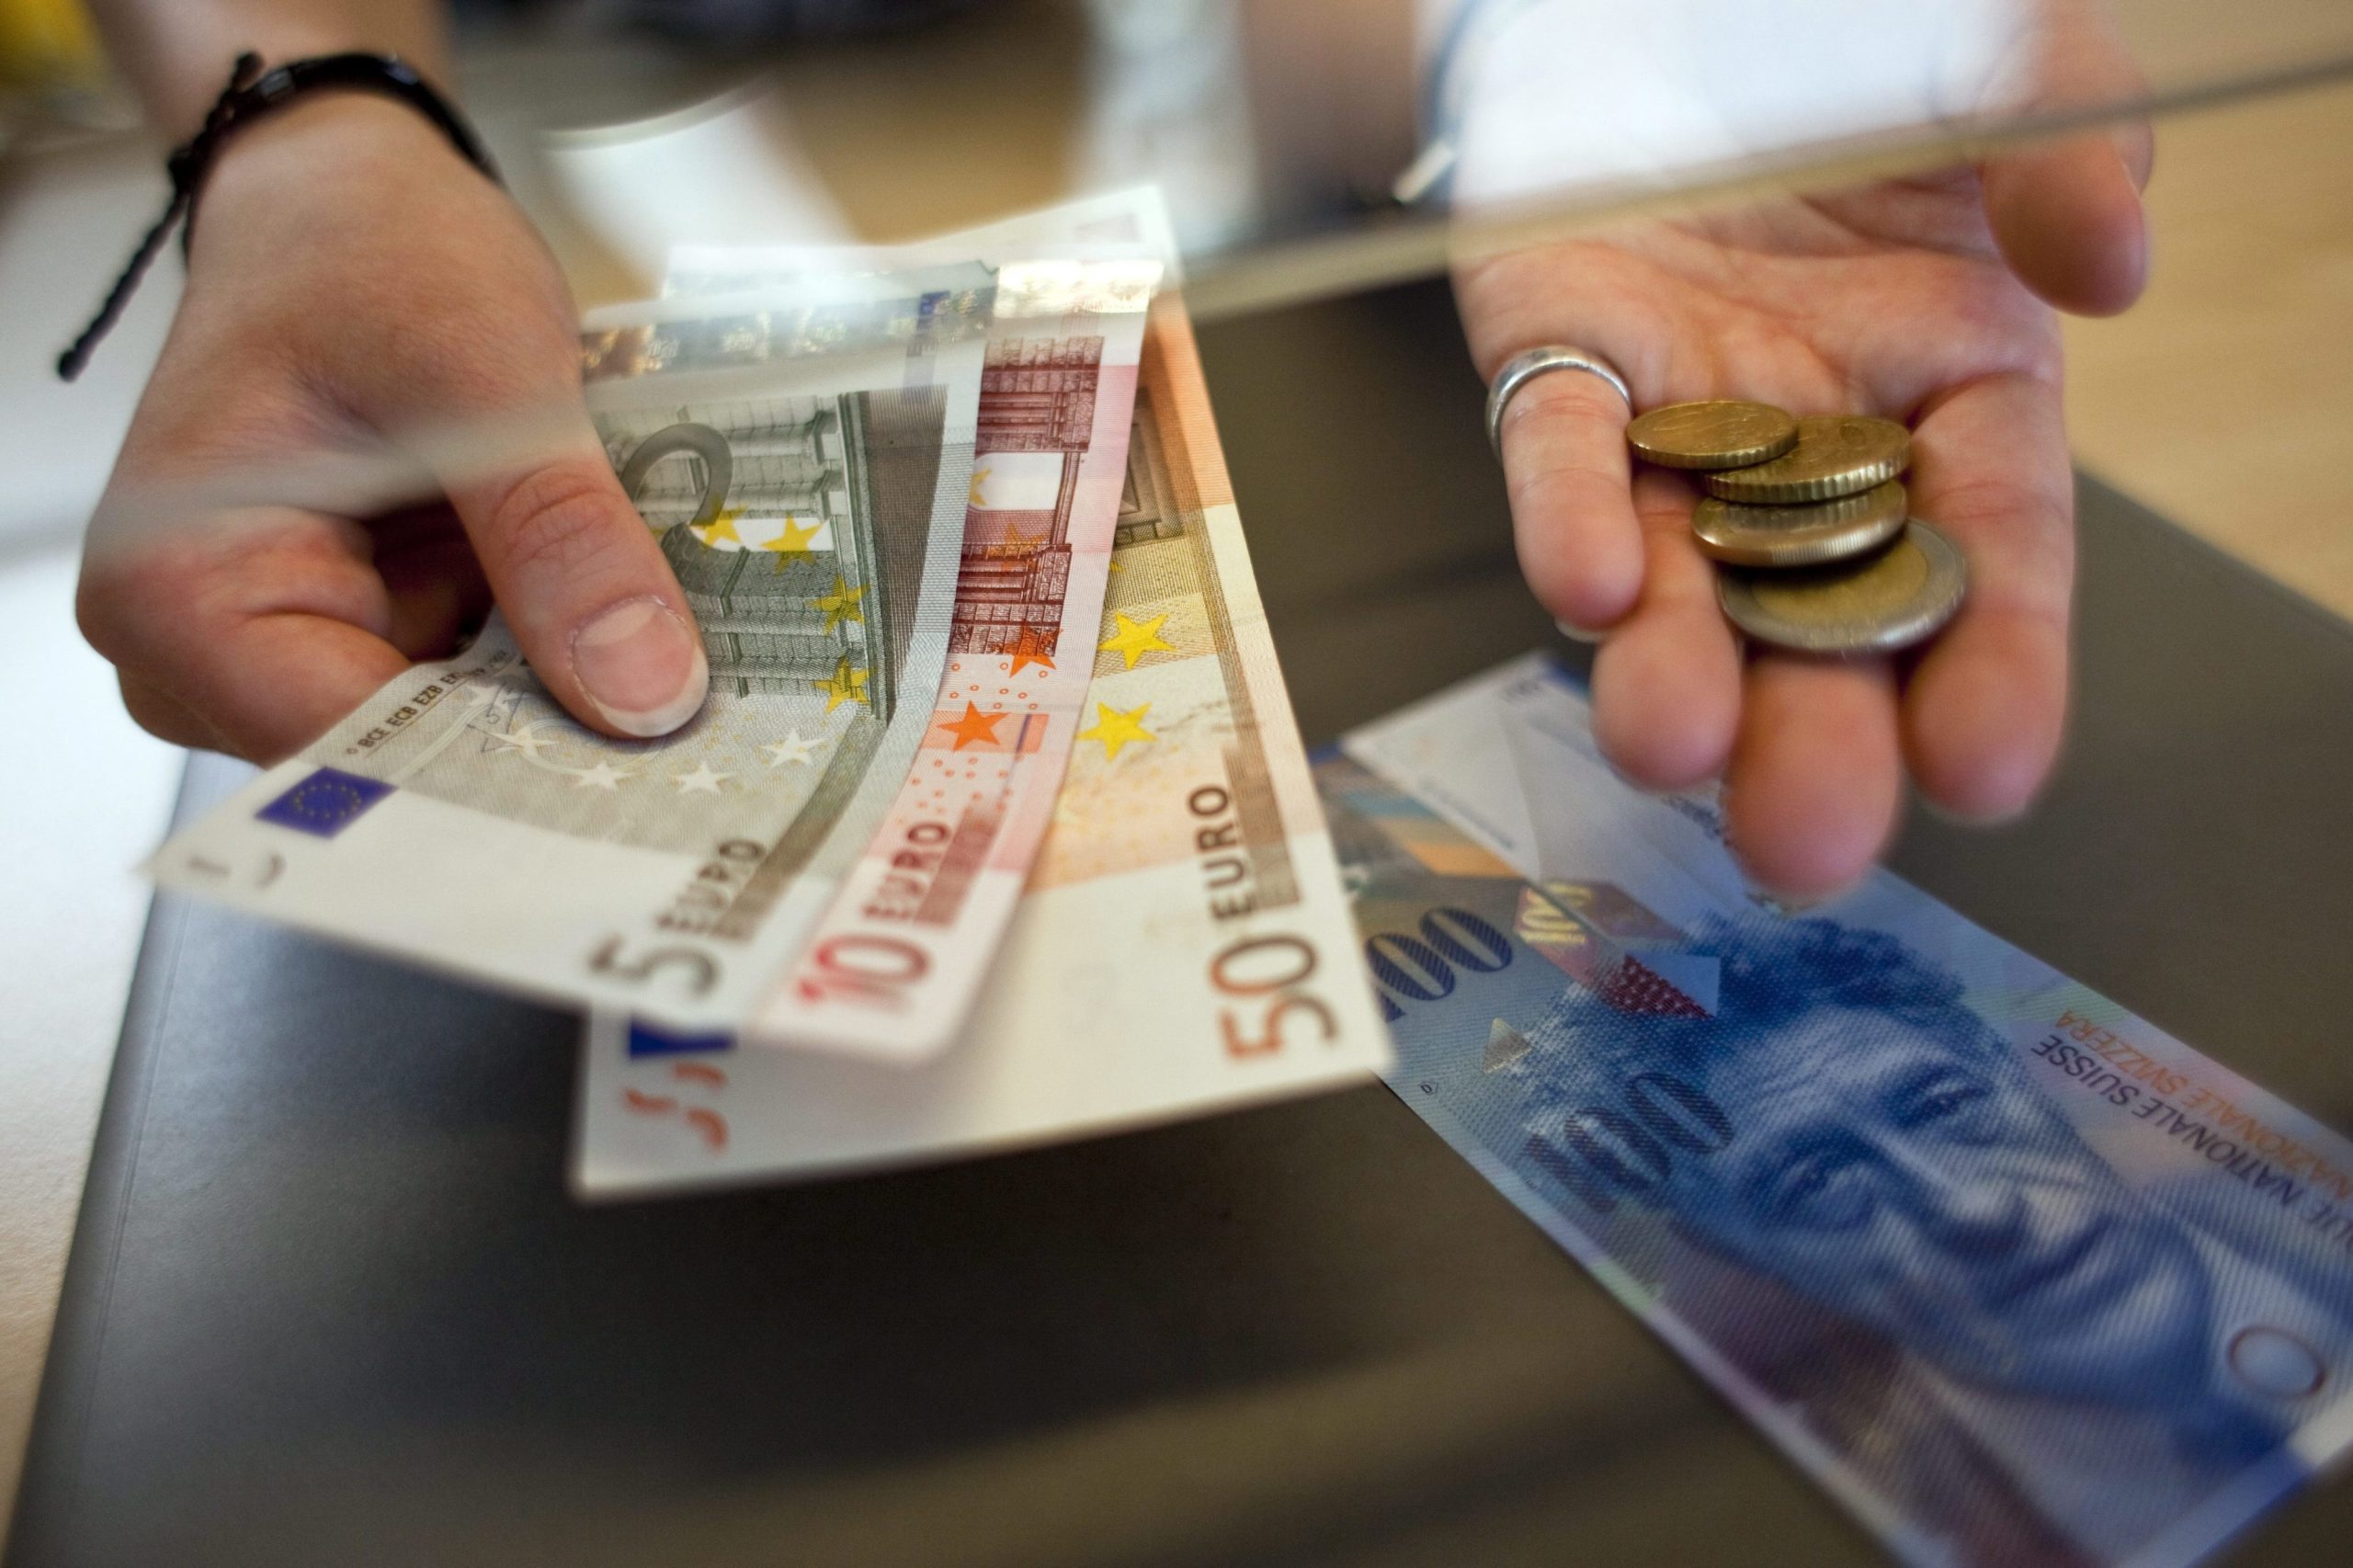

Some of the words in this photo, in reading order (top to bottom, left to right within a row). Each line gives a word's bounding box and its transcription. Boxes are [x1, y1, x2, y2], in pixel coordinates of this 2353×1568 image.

[358, 727, 391, 748] BCE
[386, 706, 417, 726] ECB
[412, 685, 443, 706] EZB
[654, 838, 768, 937] EURO
[862, 824, 950, 921] EURO
[1188, 786, 1256, 922] EURO
[588, 933, 722, 1000] 5
[798, 933, 938, 1009] 10
[1209, 932, 1340, 1062] 50
[1367, 906, 1513, 1022] 00
[2030, 1035, 2140, 1107] SUISSE
[2055, 1008, 2189, 1096] SVIZZERA
[1520, 1072, 1734, 1213] 100
[2131, 1097, 2304, 1207] NATIONALE
